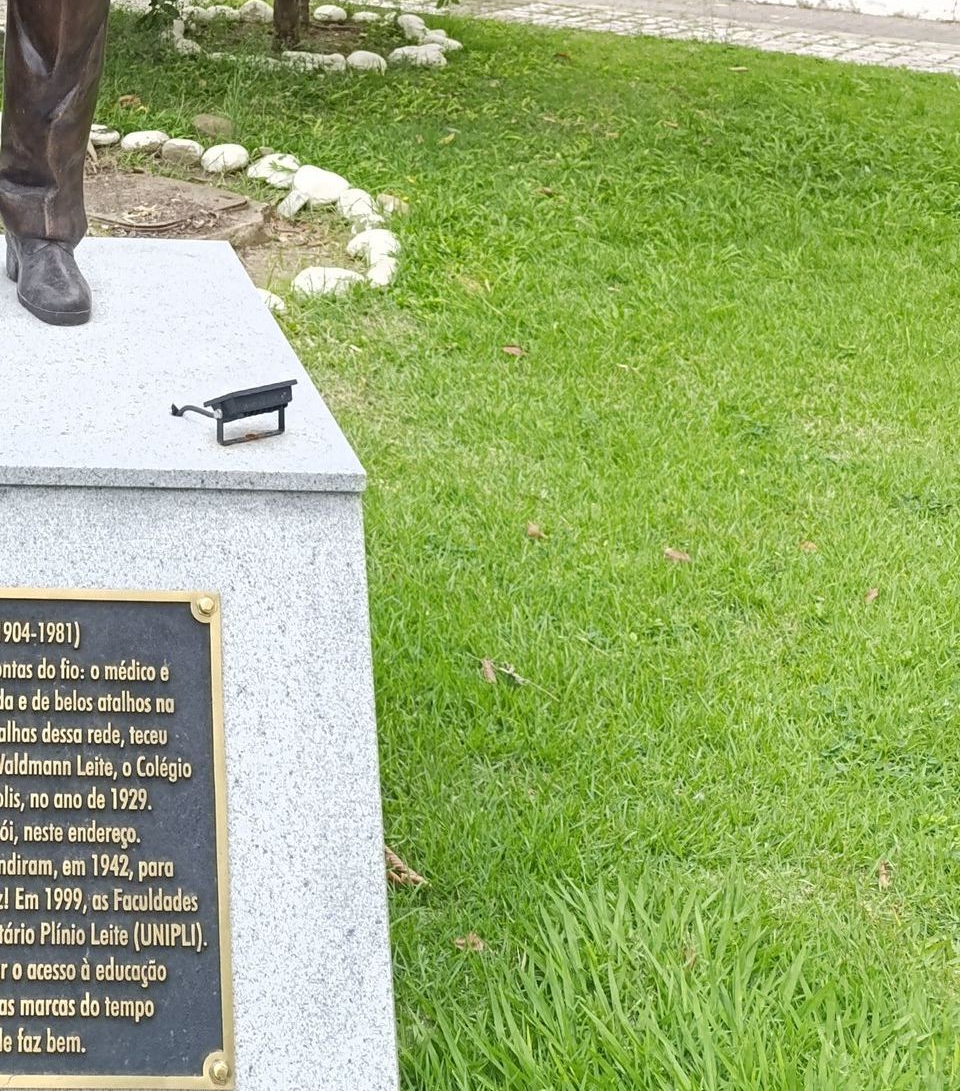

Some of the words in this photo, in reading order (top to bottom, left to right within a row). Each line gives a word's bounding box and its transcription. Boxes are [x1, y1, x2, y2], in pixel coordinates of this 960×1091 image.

[37, 657, 56, 679] do
[60, 657, 84, 679] fio:
[90, 665, 100, 680] o
[104, 659, 156, 681] médico
[160, 666, 169, 681] e
[18, 695, 27, 710] e
[31, 688, 50, 711] de
[54, 689, 93, 711] belos
[97, 690, 152, 713] atalhos
[156, 698, 174, 713] na
[41, 721, 82, 743] dessa
[87, 722, 125, 747] rede,
[129, 726, 167, 745] teceu
[77, 754, 118, 780] Leite,
[122, 761, 132, 777] o
[136, 755, 192, 782] Colégio
[30, 792, 49, 807] no
[54, 793, 82, 808] ano
[88, 786, 105, 809] de
[111, 788, 151, 809] 1929.
[24, 823, 63, 842] neste
[68, 819, 140, 849] endereço.
[62, 860, 85, 876] em
[92, 854, 133, 880] 1942,
[138, 861, 174, 882] para
[15, 887, 39, 910] Em
[45, 888, 87, 914] 1999,
[92, 895, 108, 911] as
[113, 887, 198, 912] Faculdades
[40, 920, 86, 945] Plínio
[91, 923, 128, 946] Leite
[134, 921, 207, 952] (UNIPLI).
[12, 962, 22, 980] o
[27, 963, 76, 980] acesso
[81, 957, 90, 980] à
[96, 956, 167, 988] educação
[20, 998, 76, 1016] marcas
[80, 991, 100, 1016] do
[104, 996, 154, 1022] tempo
[17, 1027, 42, 1053] faz
[46, 1027, 86, 1053] bem.
